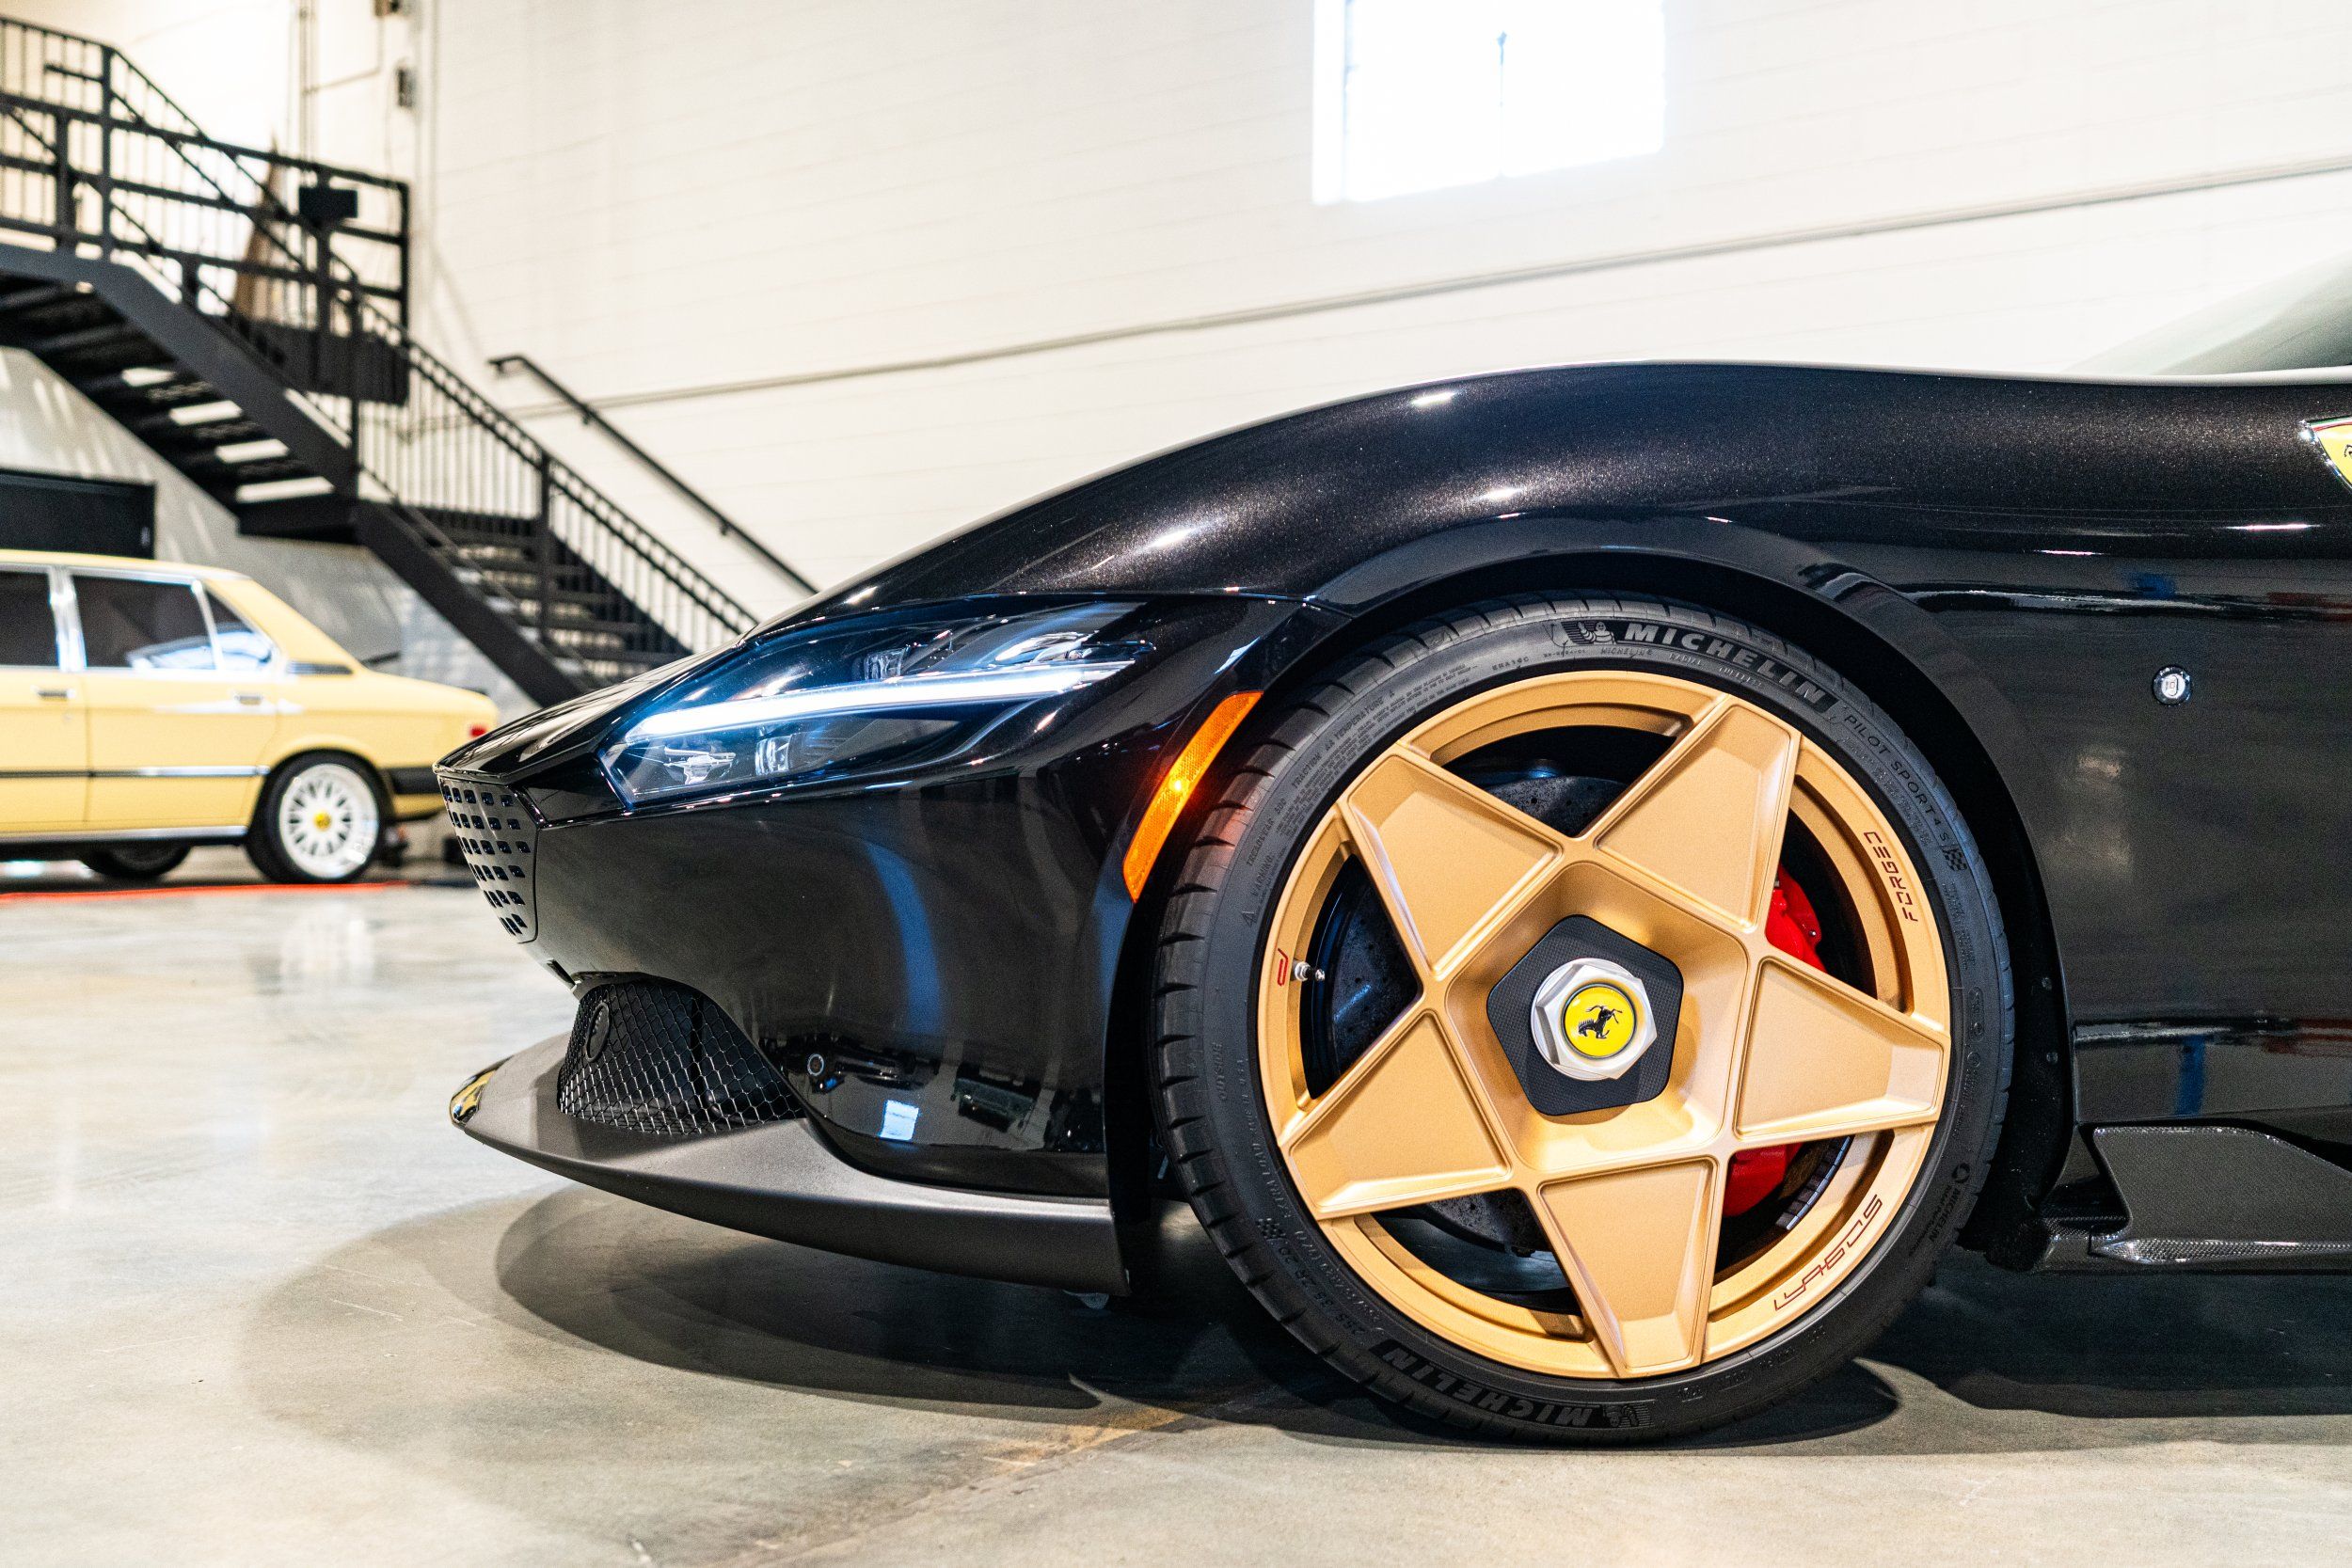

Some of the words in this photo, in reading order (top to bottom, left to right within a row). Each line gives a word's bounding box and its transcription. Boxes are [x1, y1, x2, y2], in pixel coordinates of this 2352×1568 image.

[1625, 623, 1825, 706] MICHELIN
[1843, 713, 1890, 758] PILOT
[1889, 759, 1935, 817] SPORT
[1931, 816, 1941, 827] 4
[1937, 830, 1950, 843] S
[1863, 832, 1918, 922] FORGED
[1927, 1187, 1962, 1243] MICHELIN
[1333, 1308, 1366, 1339] 255
[1384, 1345, 1592, 1427] MICHELIN
